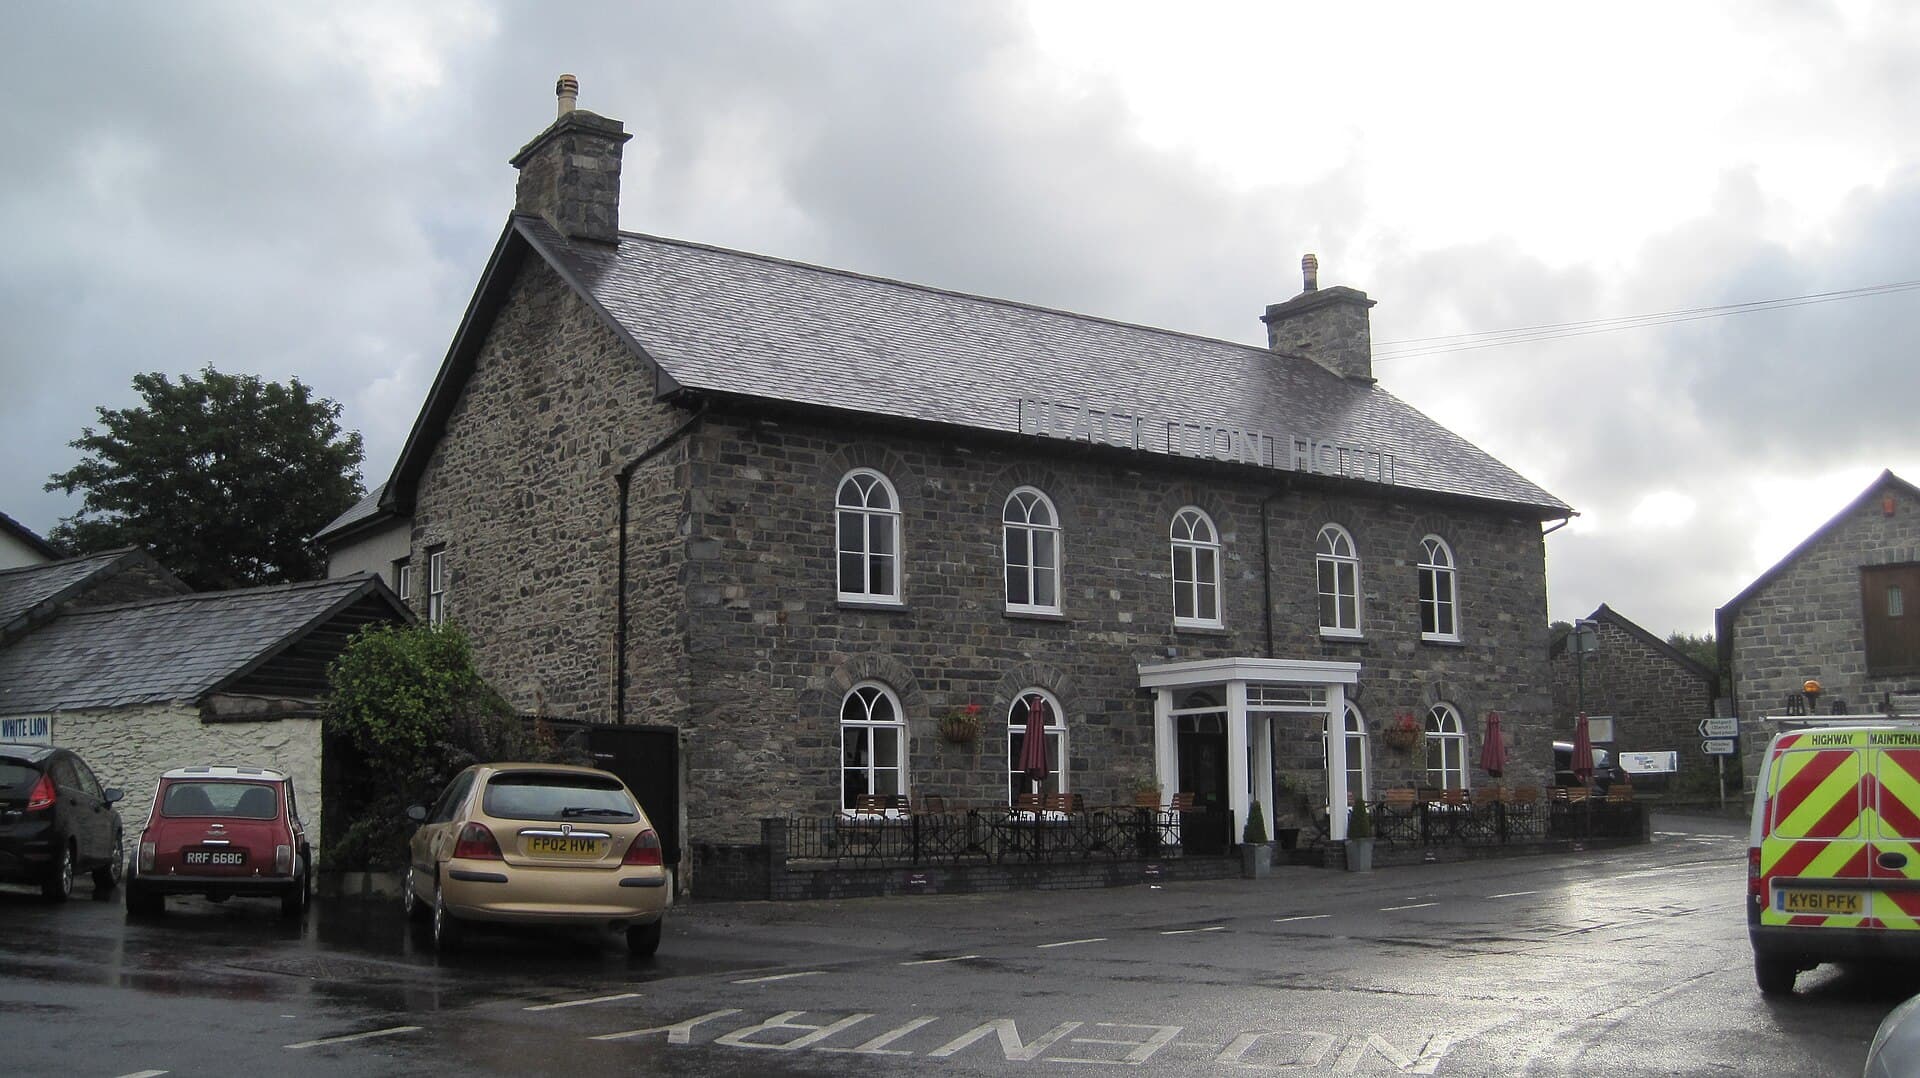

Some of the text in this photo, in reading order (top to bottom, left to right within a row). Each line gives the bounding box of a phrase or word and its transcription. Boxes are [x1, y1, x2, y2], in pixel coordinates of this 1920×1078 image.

[1021, 396, 1394, 484] BLACK LION HOTEL
[2, 717, 48, 737] WHITE LION
[1812, 733, 1853, 745] HIGHWAY
[533, 838, 595, 852] FP02 HVM
[187, 852, 210, 864] RRF
[1789, 892, 1857, 909] KY61 PFK
[587, 1008, 1456, 1075] NO ENTRY
